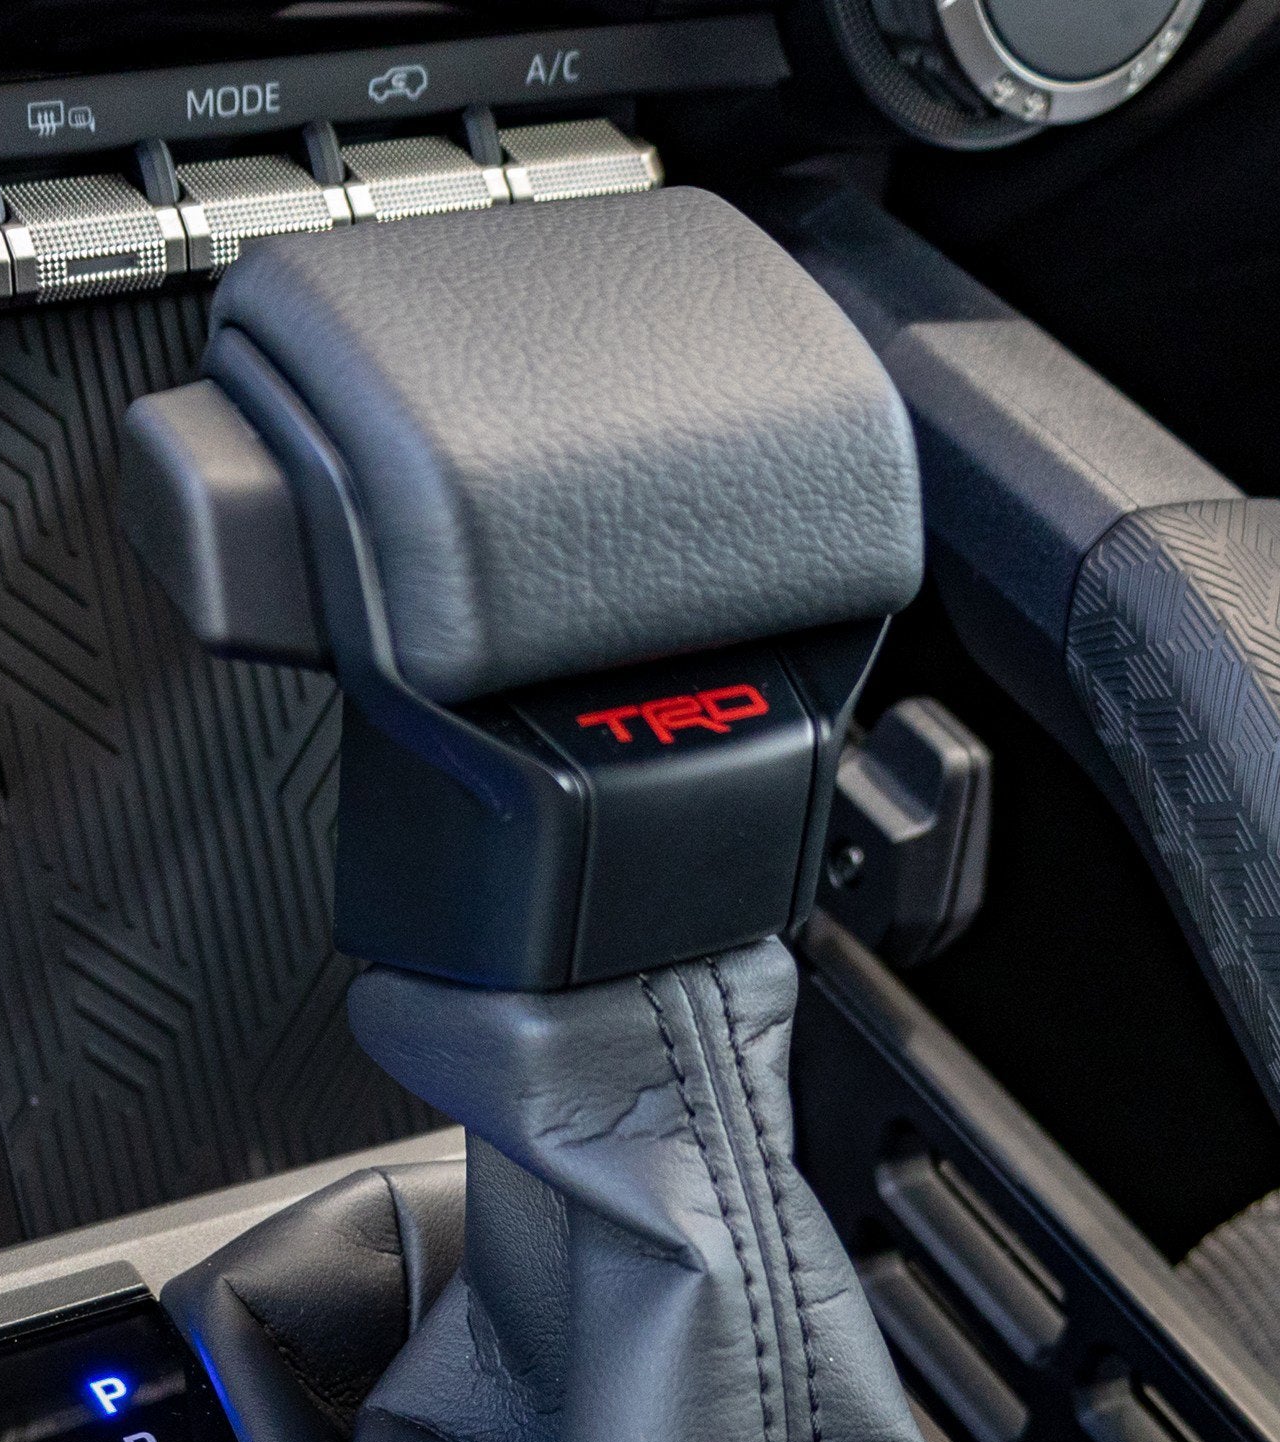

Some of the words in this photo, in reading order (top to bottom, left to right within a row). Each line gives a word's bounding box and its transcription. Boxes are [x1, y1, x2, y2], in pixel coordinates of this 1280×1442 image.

[526, 51, 580, 85] A/C
[187, 82, 280, 120] MODE
[576, 684, 769, 744] TRD
[90, 1377, 127, 1414] P
